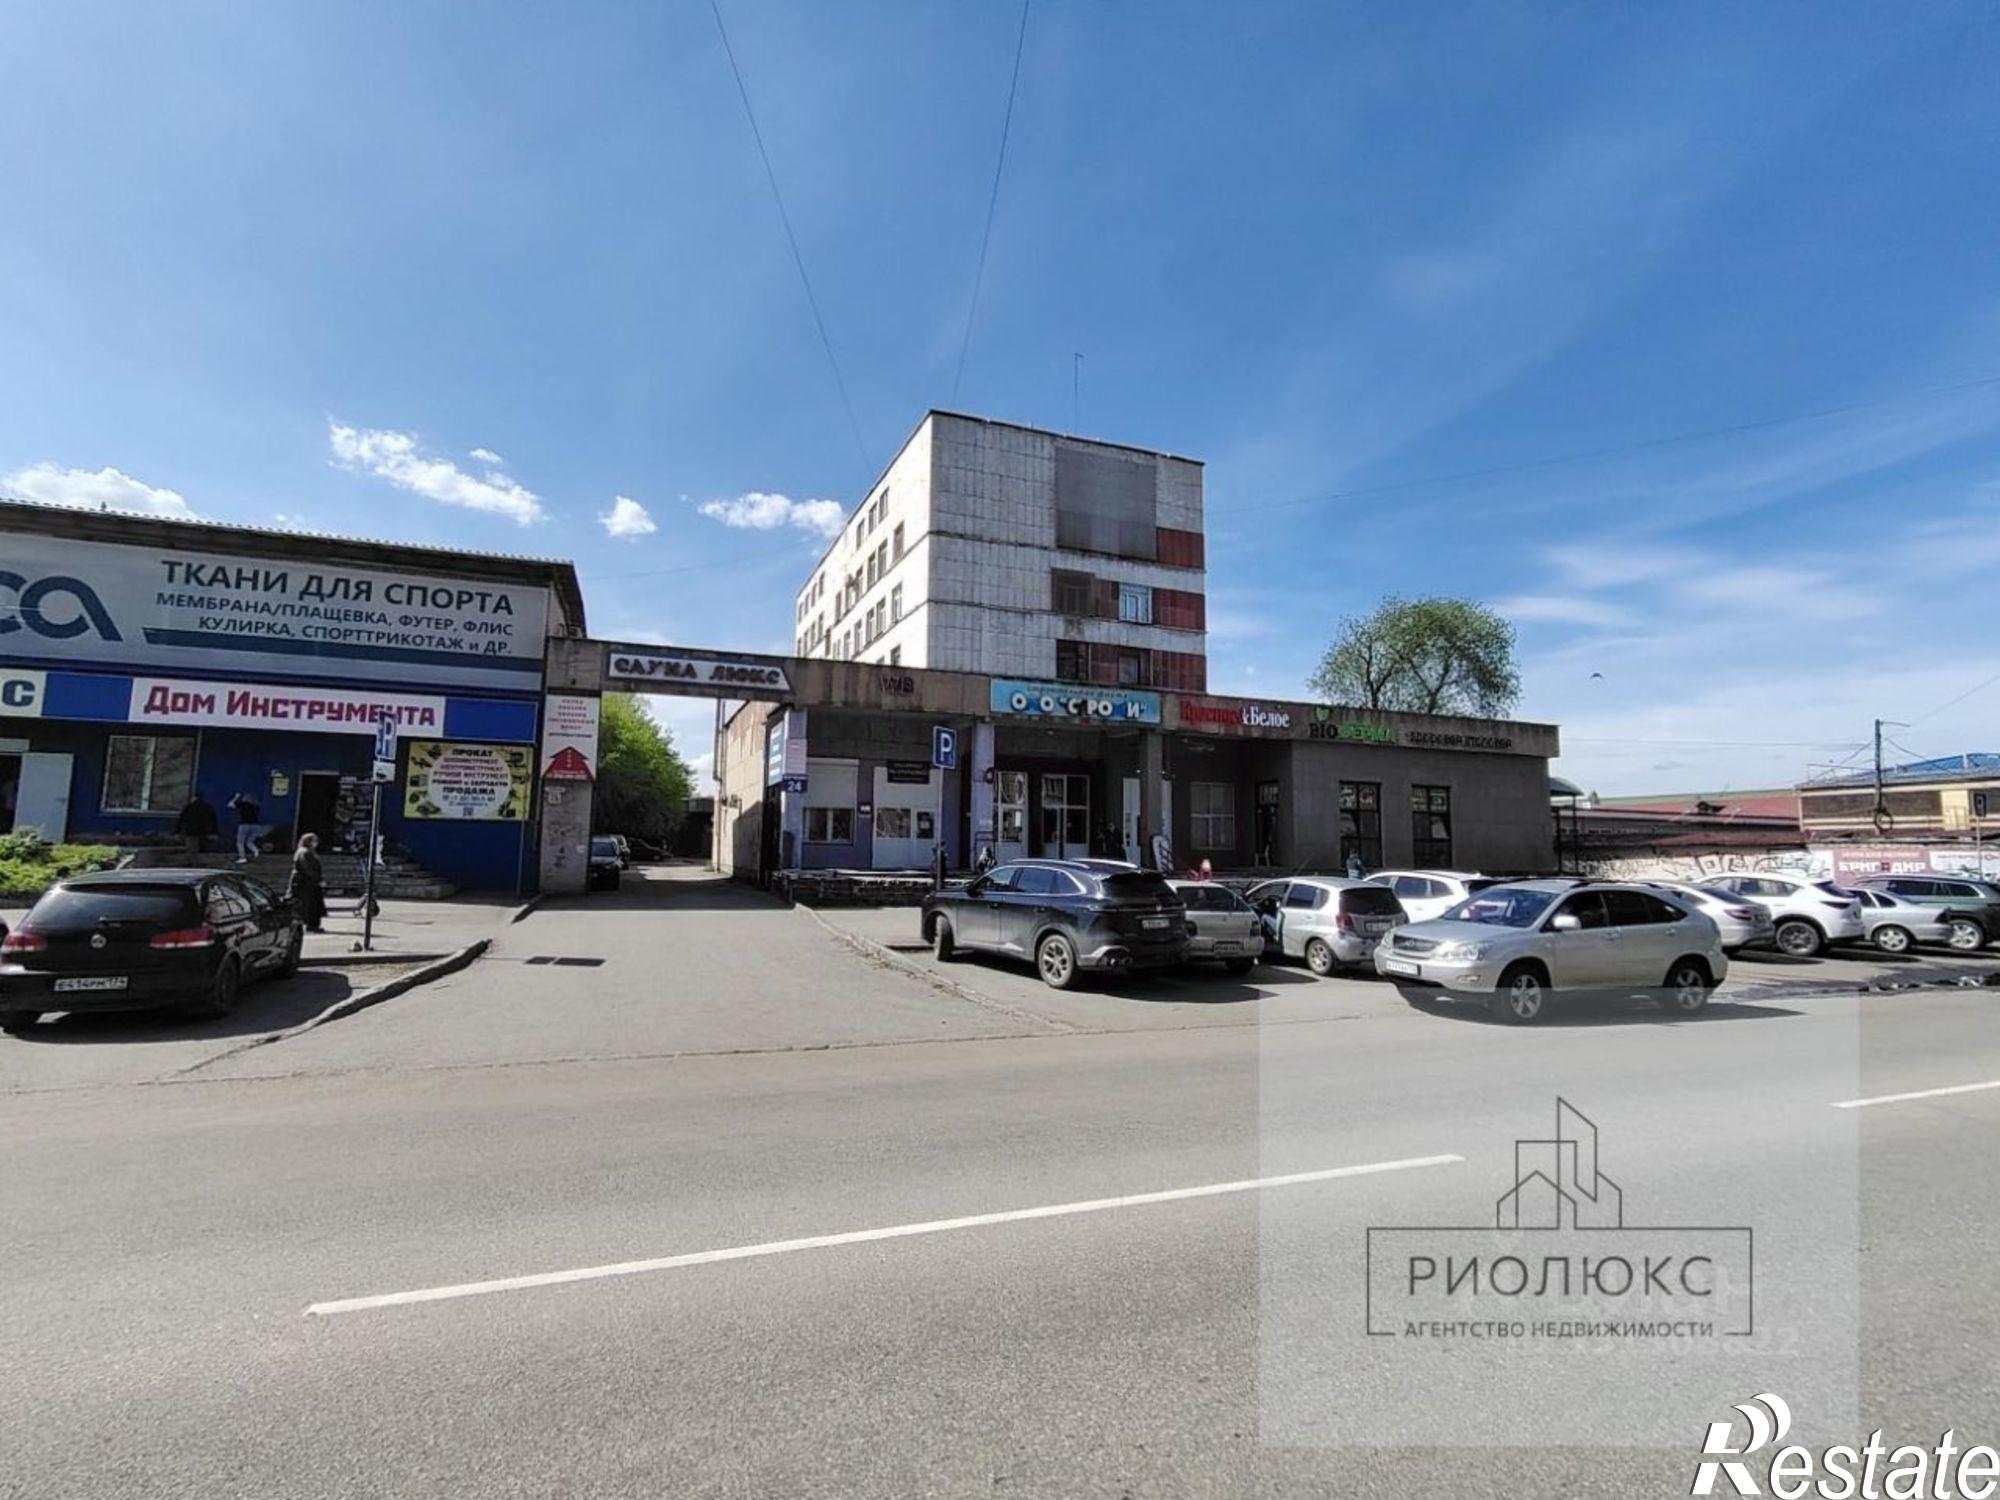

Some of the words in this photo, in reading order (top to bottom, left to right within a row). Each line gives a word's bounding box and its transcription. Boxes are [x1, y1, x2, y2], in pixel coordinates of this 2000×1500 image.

[161, 560, 288, 593] ТКАНИ
[299, 575, 372, 602] ДЛЯ
[384, 583, 513, 615] СПОРТА
[200, 616, 295, 637] КУЛИРКА,
[302, 625, 463, 651] СПОРТТРИКОТАЖ
[399, 615, 457, 632] ФУТЕР,
[463, 621, 513, 636] ФЛИС
[614, 657, 697, 679] САУНА
[709, 665, 780, 684] ЛЮКС
[452, 748, 493, 757] ПРОКАТ
[940, 732, 953, 762] P
[442, 786, 495, 795] ПРОДАЖА
[787, 781, 802, 792] 24
